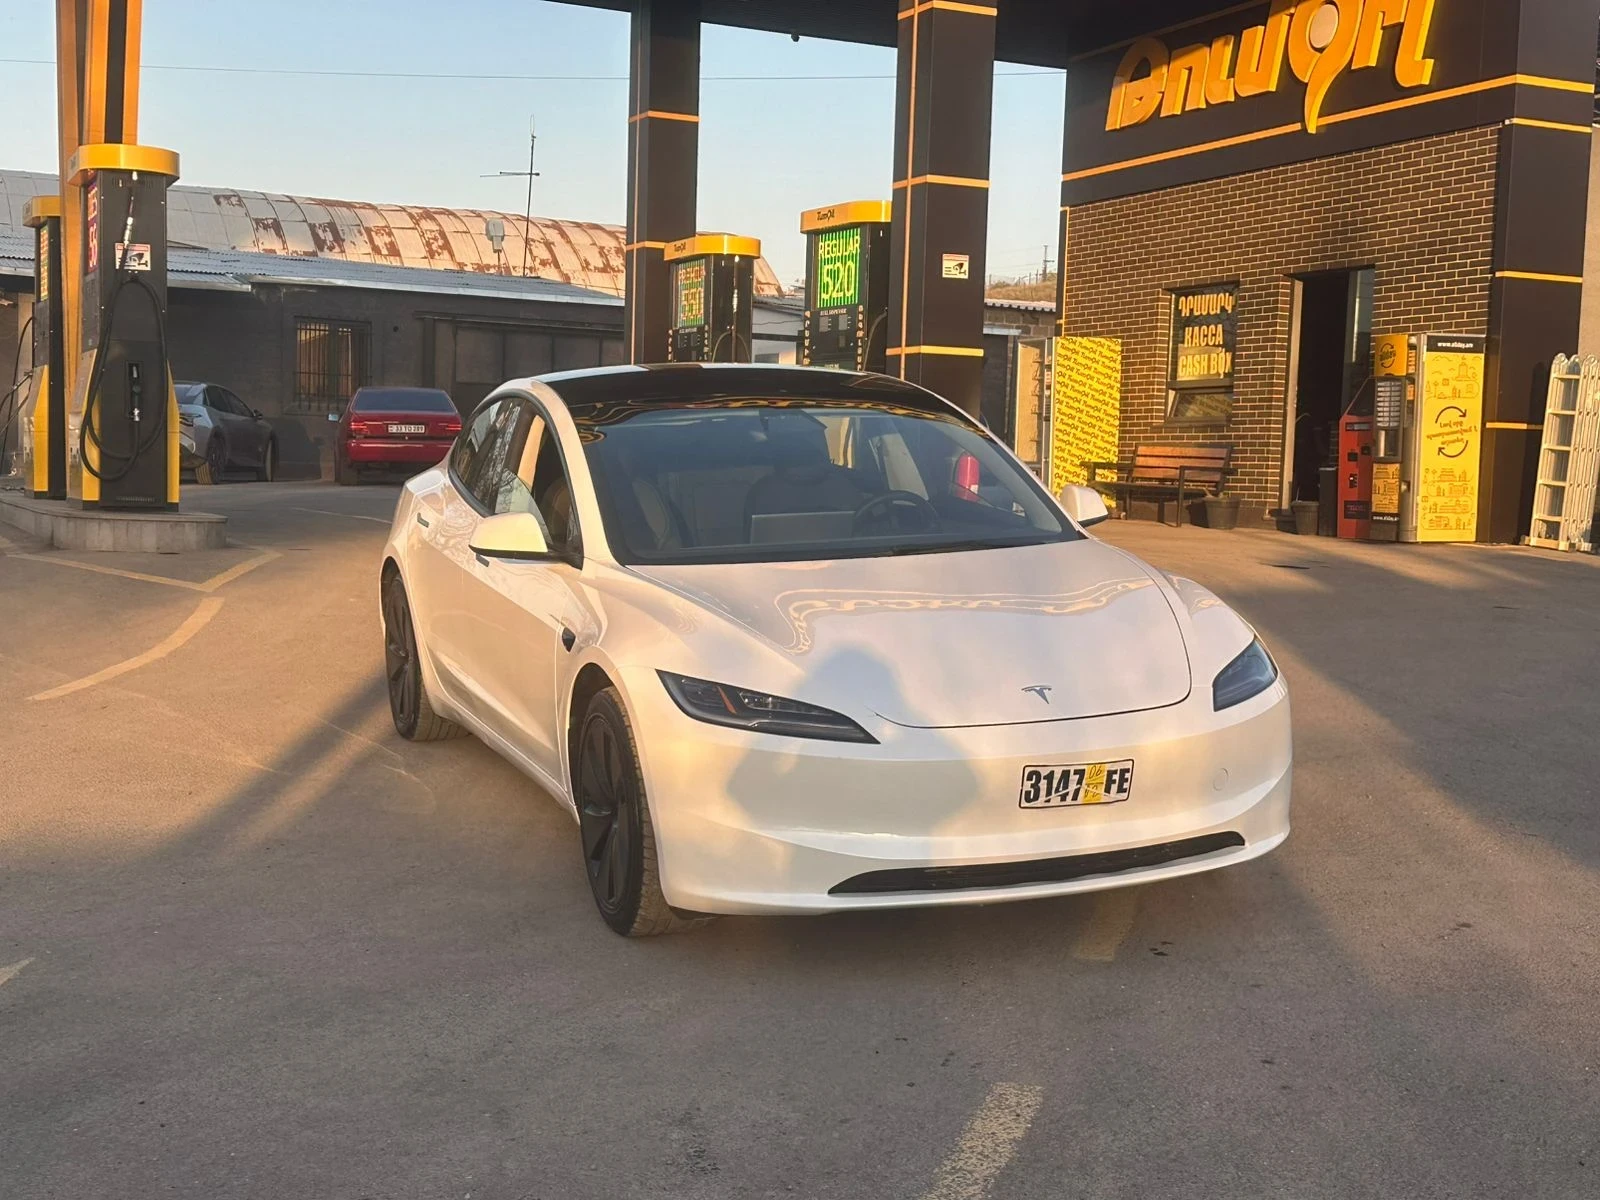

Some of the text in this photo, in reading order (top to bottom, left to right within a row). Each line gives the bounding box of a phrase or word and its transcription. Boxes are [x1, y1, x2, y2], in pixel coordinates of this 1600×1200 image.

[819, 235, 861, 261] REGULAR
[822, 260, 855, 300] 520
[1178, 292, 1234, 317] ԴՐԱՄԱՐԿ
[1184, 324, 1224, 347] КАССА
[1179, 350, 1233, 378] CASH BOX
[1024, 767, 1131, 803] 3147 FE
